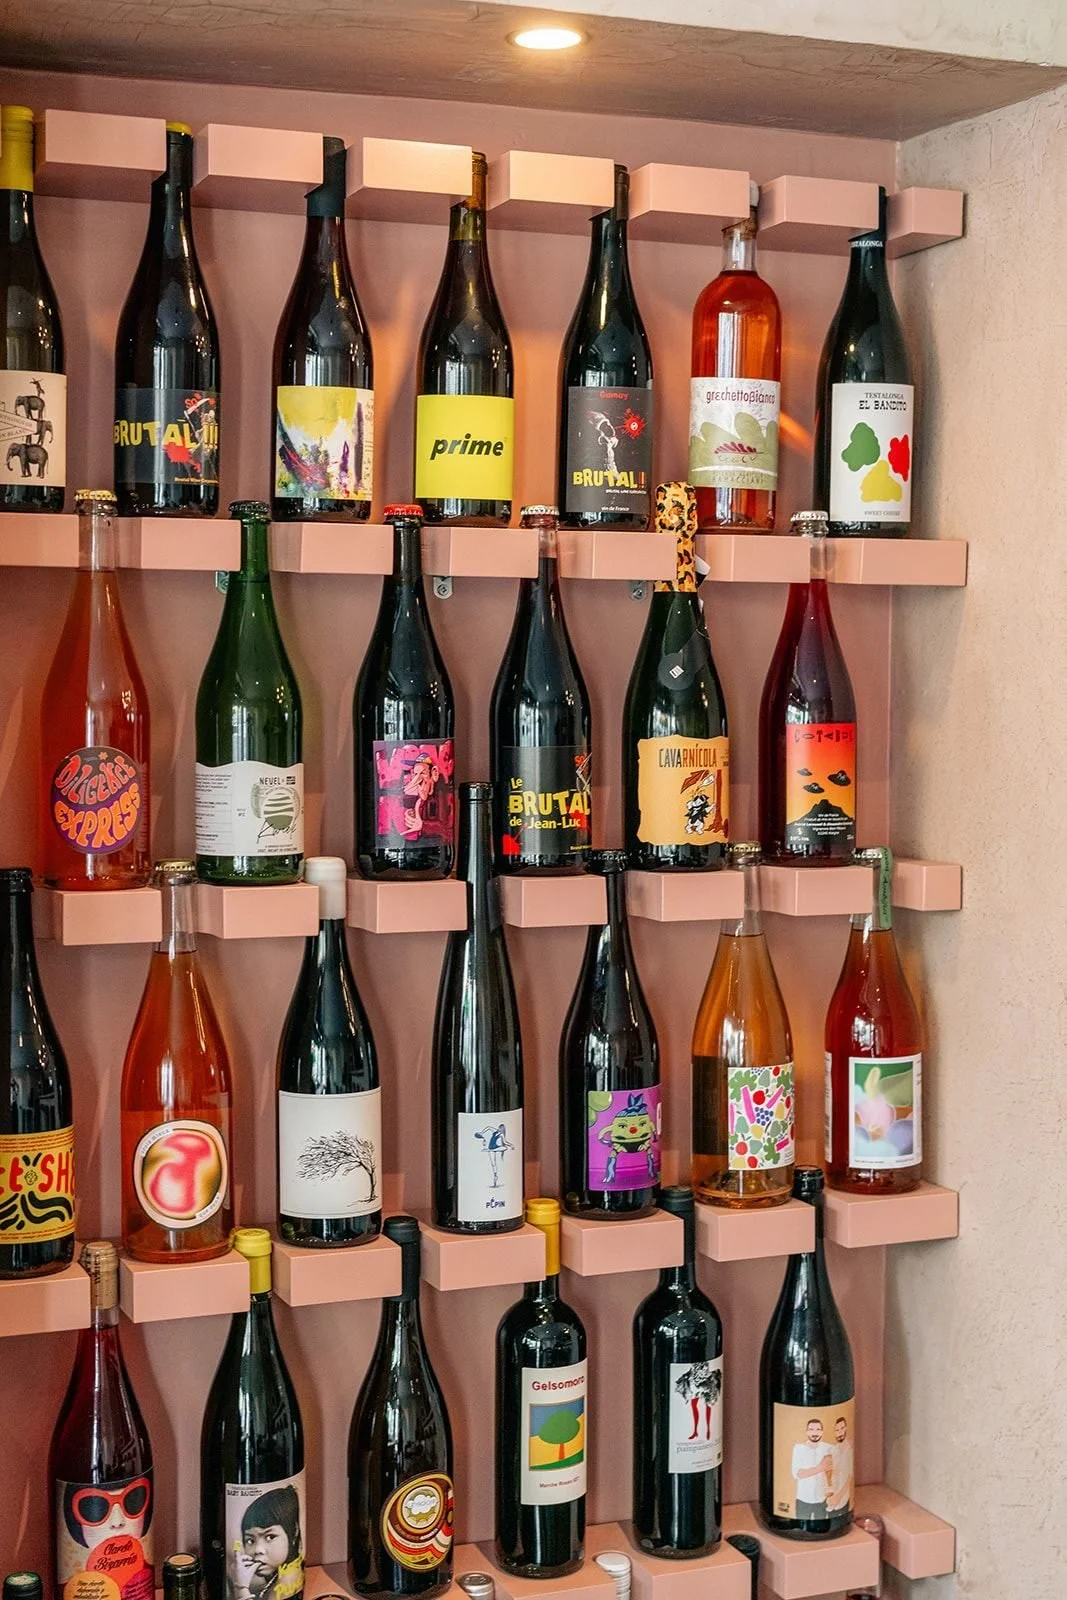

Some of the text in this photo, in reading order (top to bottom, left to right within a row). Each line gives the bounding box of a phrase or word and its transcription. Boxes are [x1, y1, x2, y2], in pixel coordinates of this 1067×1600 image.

[859, 400, 907, 411] EL BANDITO
[430, 433, 504, 460] prime
[659, 744, 717, 768] CAVARNÍCOLA
[510, 777, 524, 789] Le
[508, 790, 591, 816] BRUTAL
[54, 783, 140, 849] EXPRESS
[509, 816, 582, 829] de Jean-Luc
